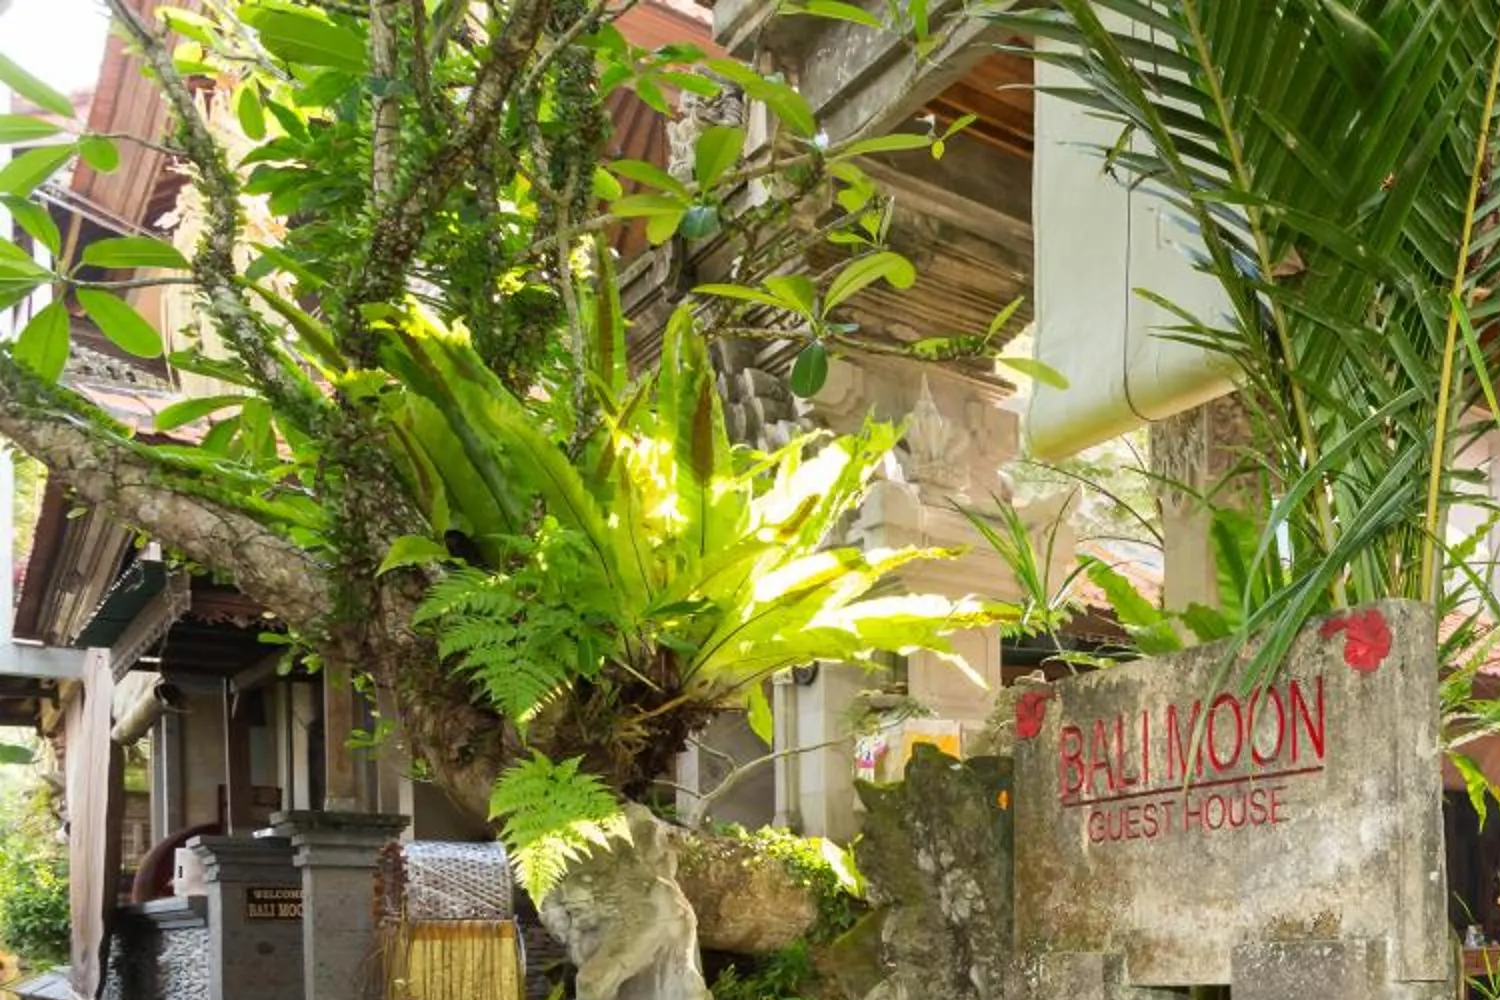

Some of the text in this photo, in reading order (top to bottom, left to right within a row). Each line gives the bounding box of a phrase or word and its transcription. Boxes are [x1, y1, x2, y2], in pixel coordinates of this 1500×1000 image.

[1060, 675, 1325, 801] BALI MOON
[1087, 785, 1290, 843] GUEST HOUSE
